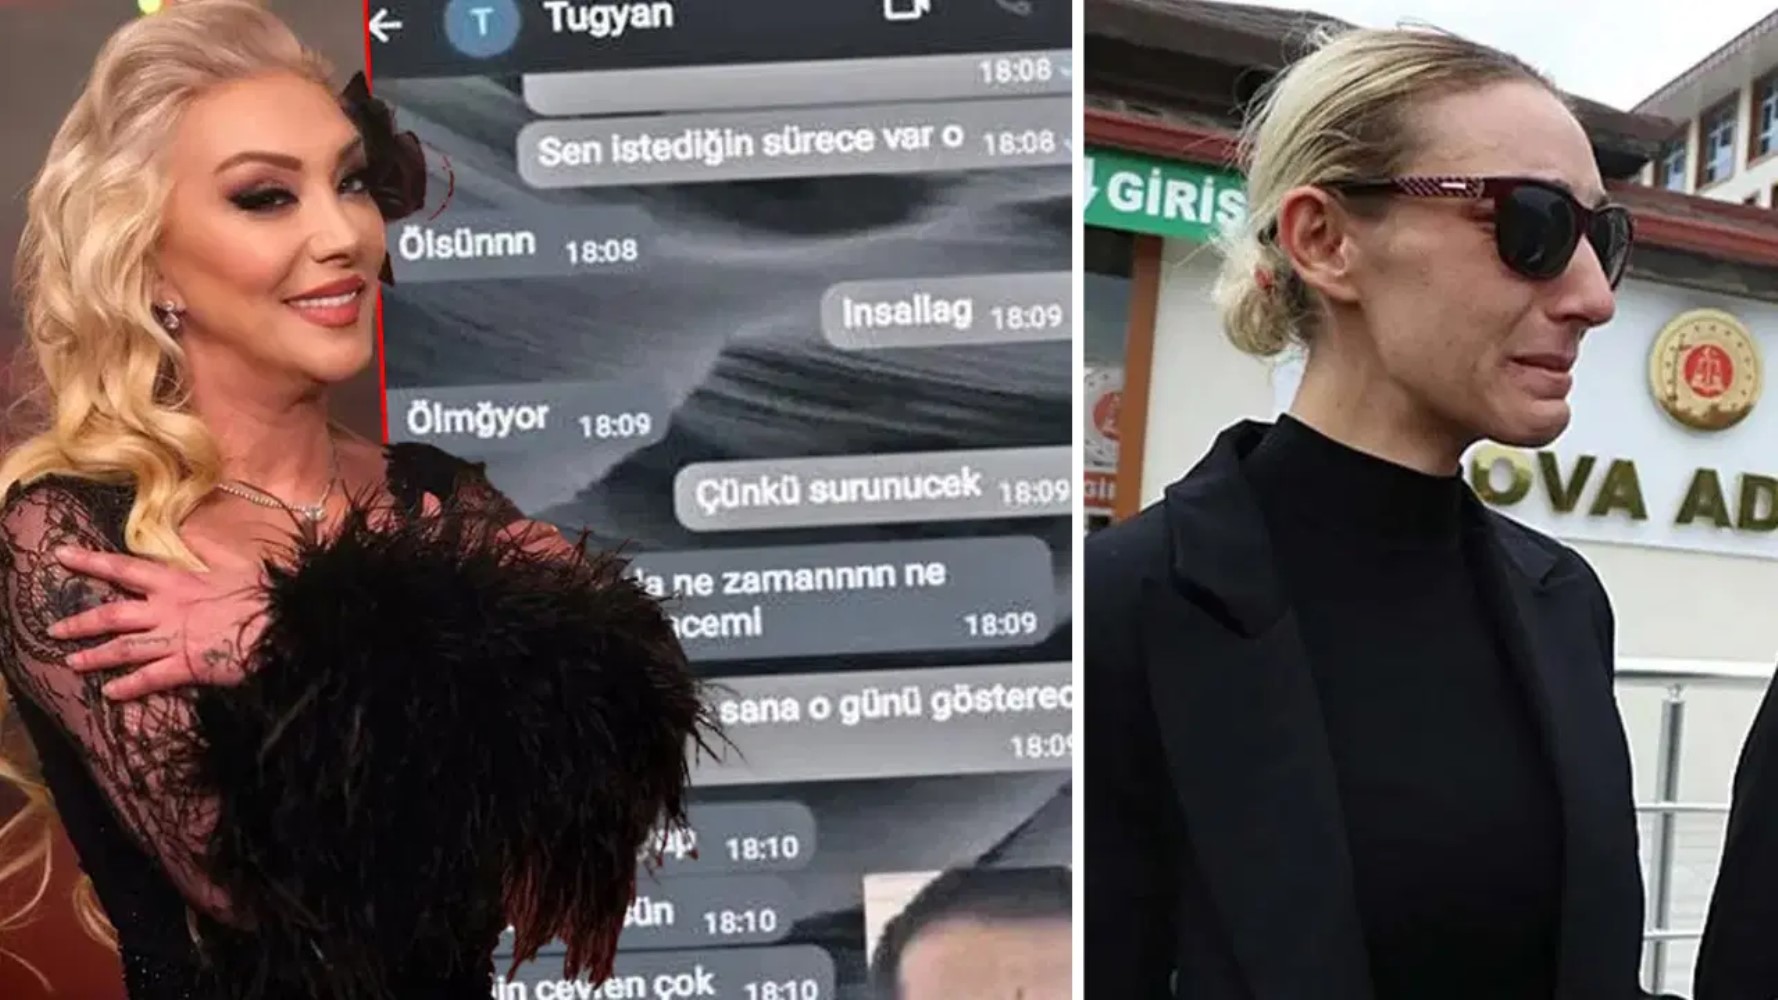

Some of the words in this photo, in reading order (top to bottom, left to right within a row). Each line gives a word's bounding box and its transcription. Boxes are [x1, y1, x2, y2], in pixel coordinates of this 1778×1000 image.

[470, 7, 494, 35] T
[543, 0, 674, 37] Tugyan
[980, 58, 1051, 84] 18:08
[537, 135, 601, 167] Sen
[611, 128, 753, 165] istediğin
[763, 126, 874, 155] sürece
[882, 125, 933, 149] var
[942, 124, 964, 147] o
[984, 129, 1056, 156] 18:08
[400, 225, 535, 261] Ölsünnn
[566, 238, 638, 264] 18:08
[843, 293, 973, 329] Insallag
[991, 304, 1062, 330] 18:09
[407, 399, 549, 438] Ölmğyor
[579, 412, 650, 438] 18:09
[696, 474, 801, 516] Çünkü
[808, 466, 982, 504] surunucek
[999, 478, 1071, 506] 18:09
[1470, 447, 1647, 521] OVA
[1675, 468, 1778, 532] AD
[673, 572, 714, 597] ne
[722, 564, 896, 595] zamannnn
[905, 561, 946, 586] ne
[964, 611, 1038, 636] 18:09
[720, 696, 801, 723] sana
[808, 696, 831, 720] o
[838, 688, 922, 725] günü
[726, 835, 799, 861] 18:10
[704, 910, 777, 935] 18:10
[653, 965, 716, 1000] çok
[745, 980, 819, 1000] 18:10
